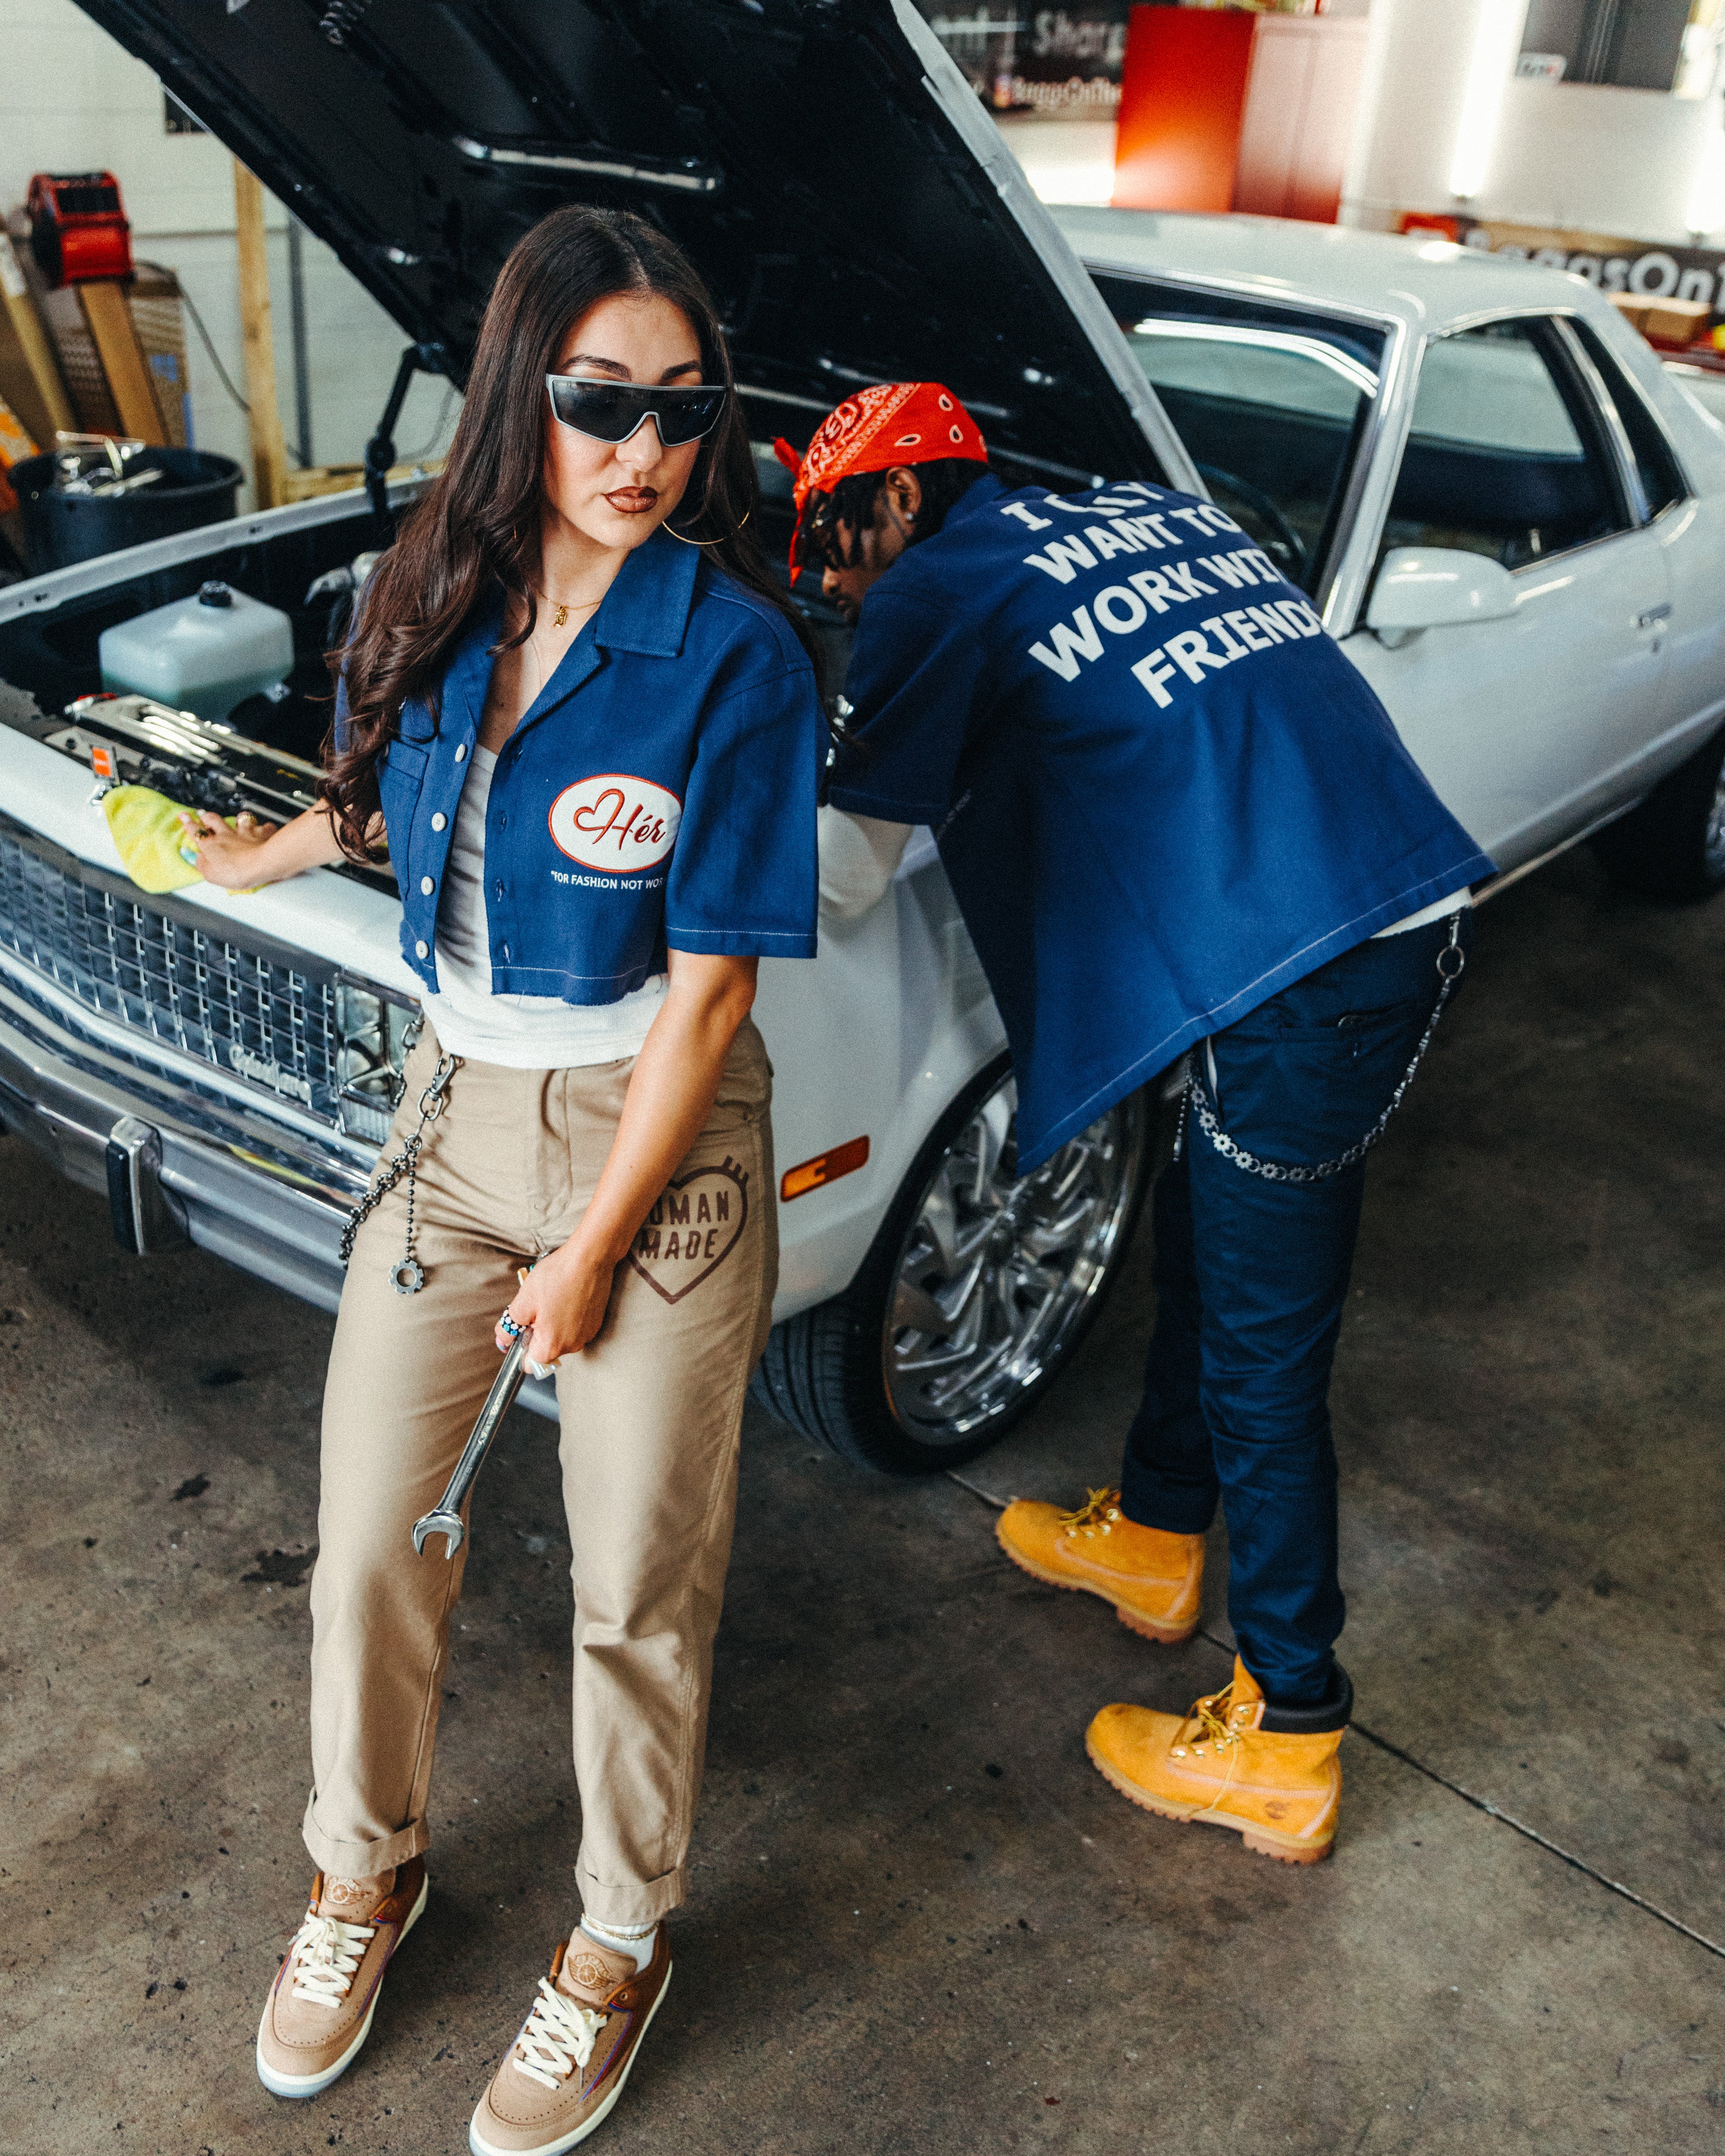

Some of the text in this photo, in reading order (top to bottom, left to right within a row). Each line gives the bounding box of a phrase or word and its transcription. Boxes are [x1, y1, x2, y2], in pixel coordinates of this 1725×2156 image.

[1000, 502, 1053, 531] I
[1023, 504, 1242, 584] WANT TO
[1028, 561, 1219, 682] WORK
[571, 875, 617, 889] FASHION
[621, 880, 643, 890] NOT
[648, 1190, 729, 1225] UMAN
[638, 1228, 718, 1260] MADE
